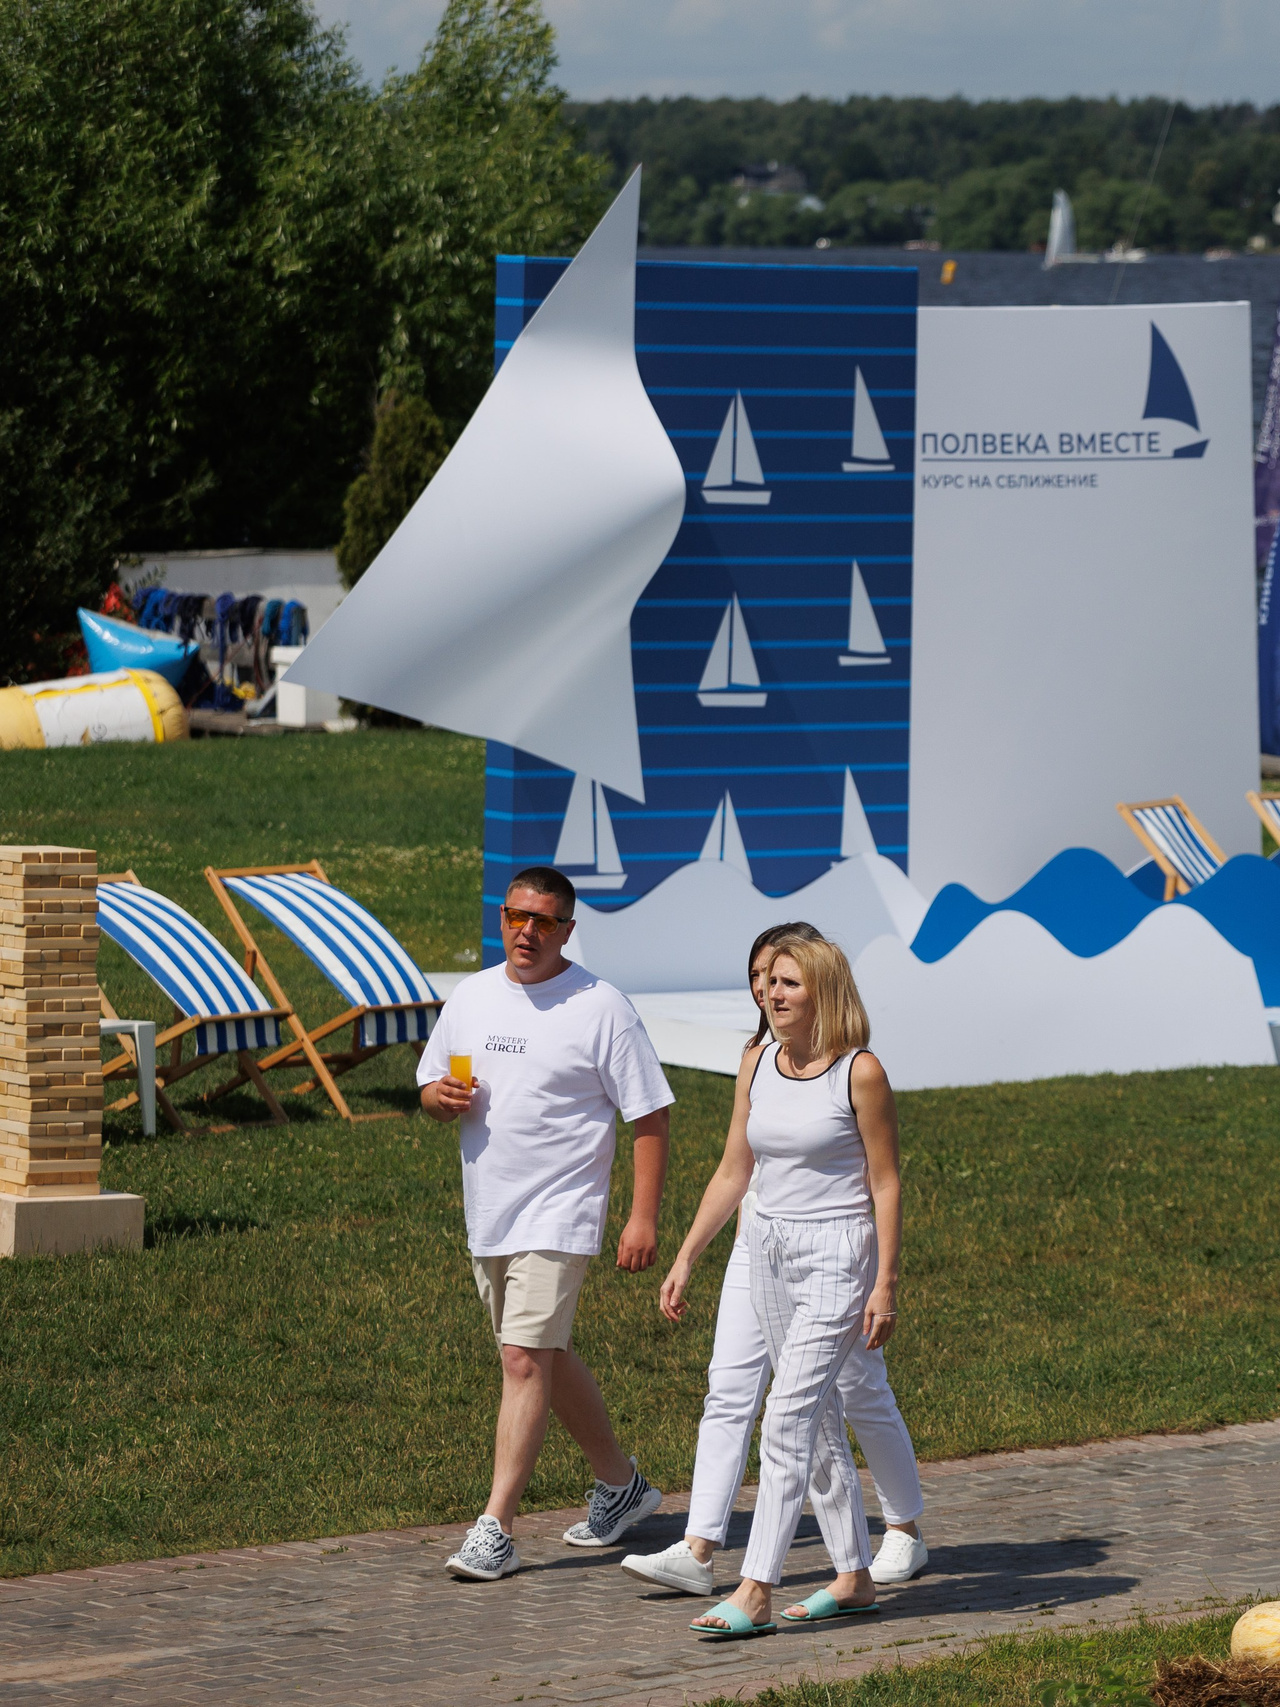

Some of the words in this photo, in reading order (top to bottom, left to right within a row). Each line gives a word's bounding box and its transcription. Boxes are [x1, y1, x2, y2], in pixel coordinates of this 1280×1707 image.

[921, 432, 1050, 455] ПОЛВЕКА
[1059, 431, 1161, 455] ВМЕСТЕ
[921, 474, 964, 489] КУРС
[969, 474, 992, 489] НА
[996, 473, 1098, 489] СБЛИЖЕНИЕ
[487, 1035, 528, 1045] MYSTERY
[485, 1042, 527, 1054] CIRCLE
